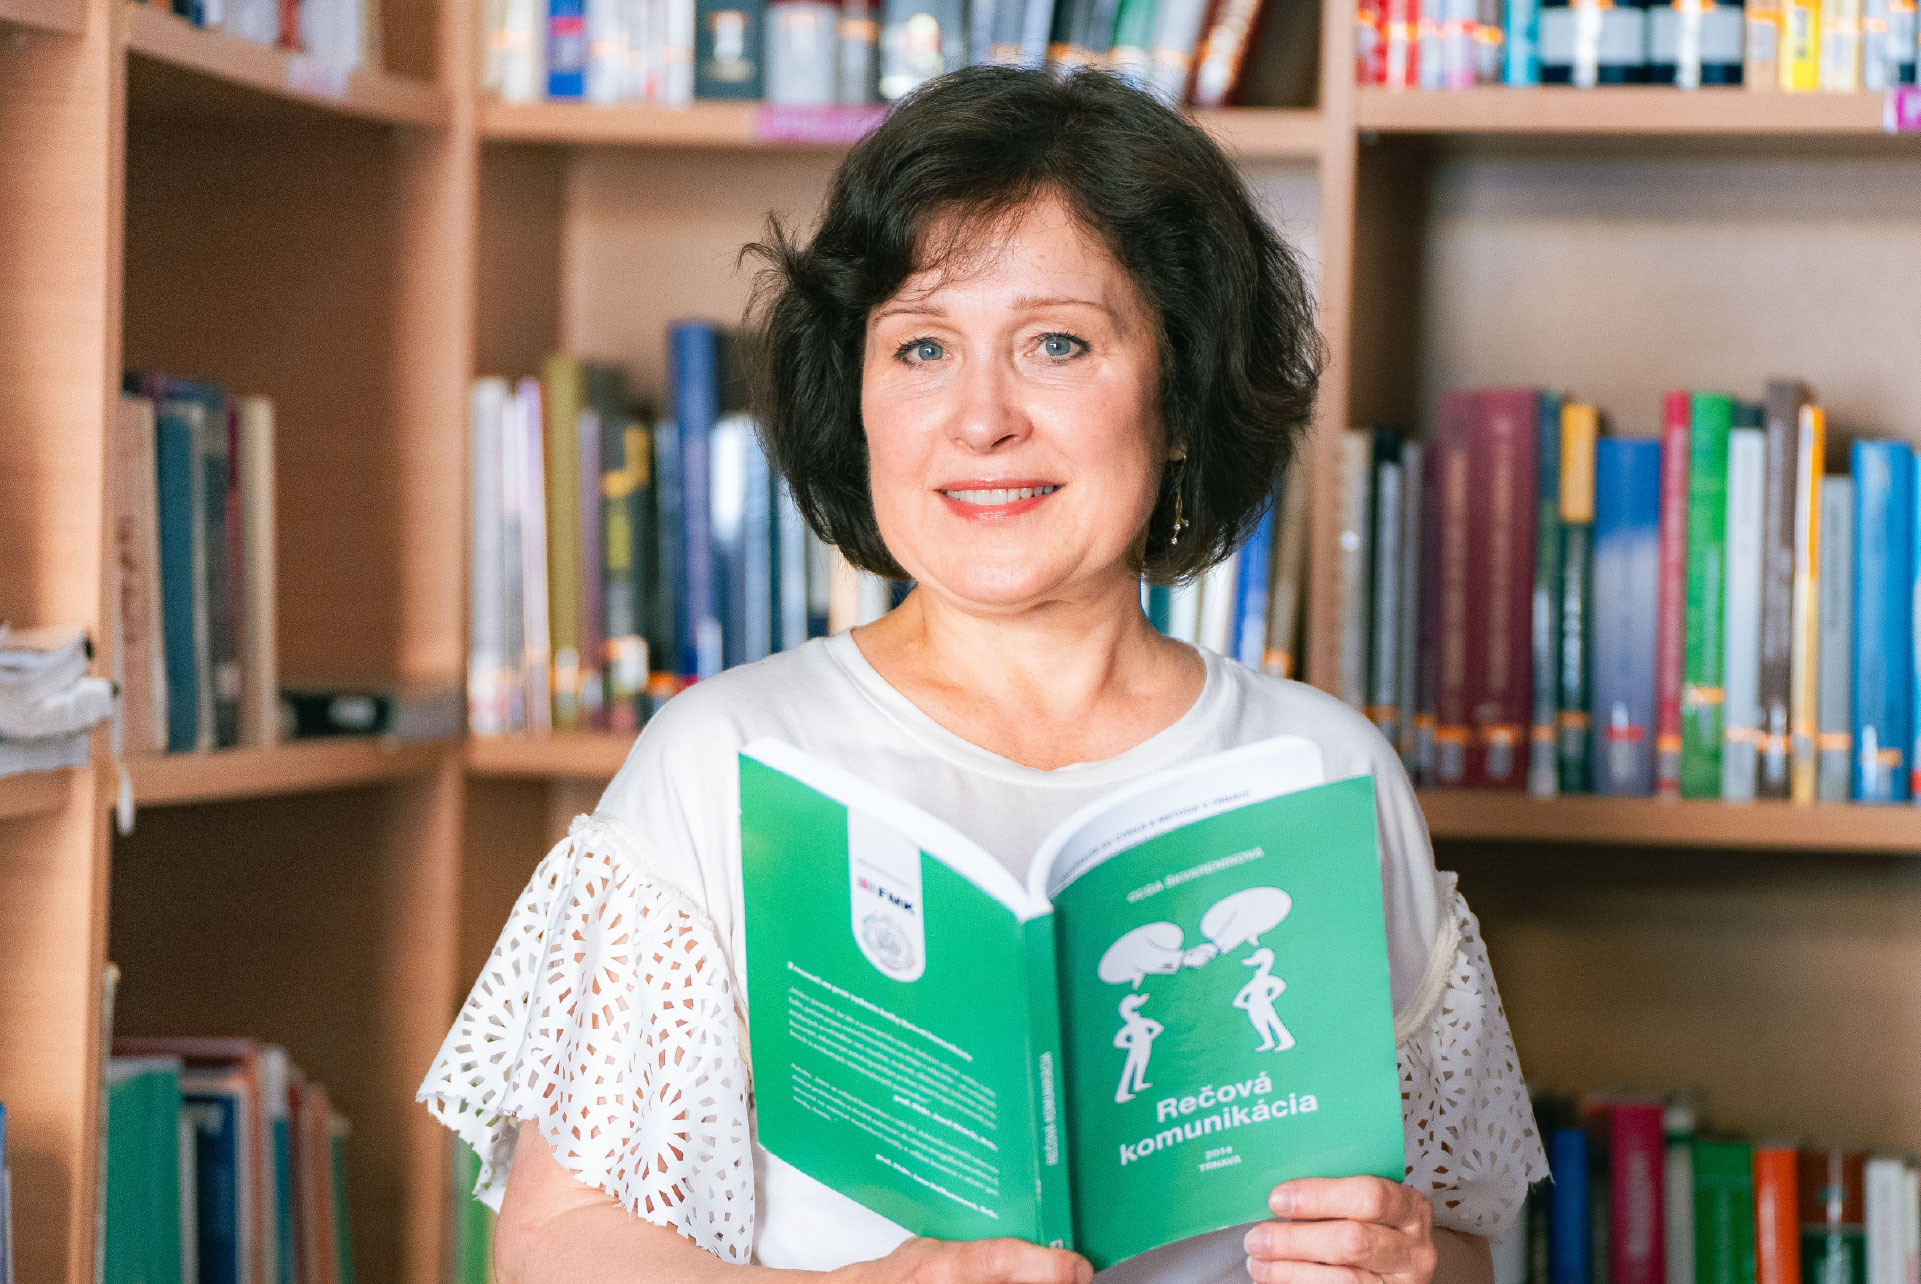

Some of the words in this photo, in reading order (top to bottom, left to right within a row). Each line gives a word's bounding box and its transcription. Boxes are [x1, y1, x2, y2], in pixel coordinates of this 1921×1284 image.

[1156, 1071, 1273, 1123] Rečová
[1119, 1092, 1319, 1166] komunikácia
[1197, 1154, 1242, 1172] TRNAVA
[1204, 1145, 1234, 1160] 2014
